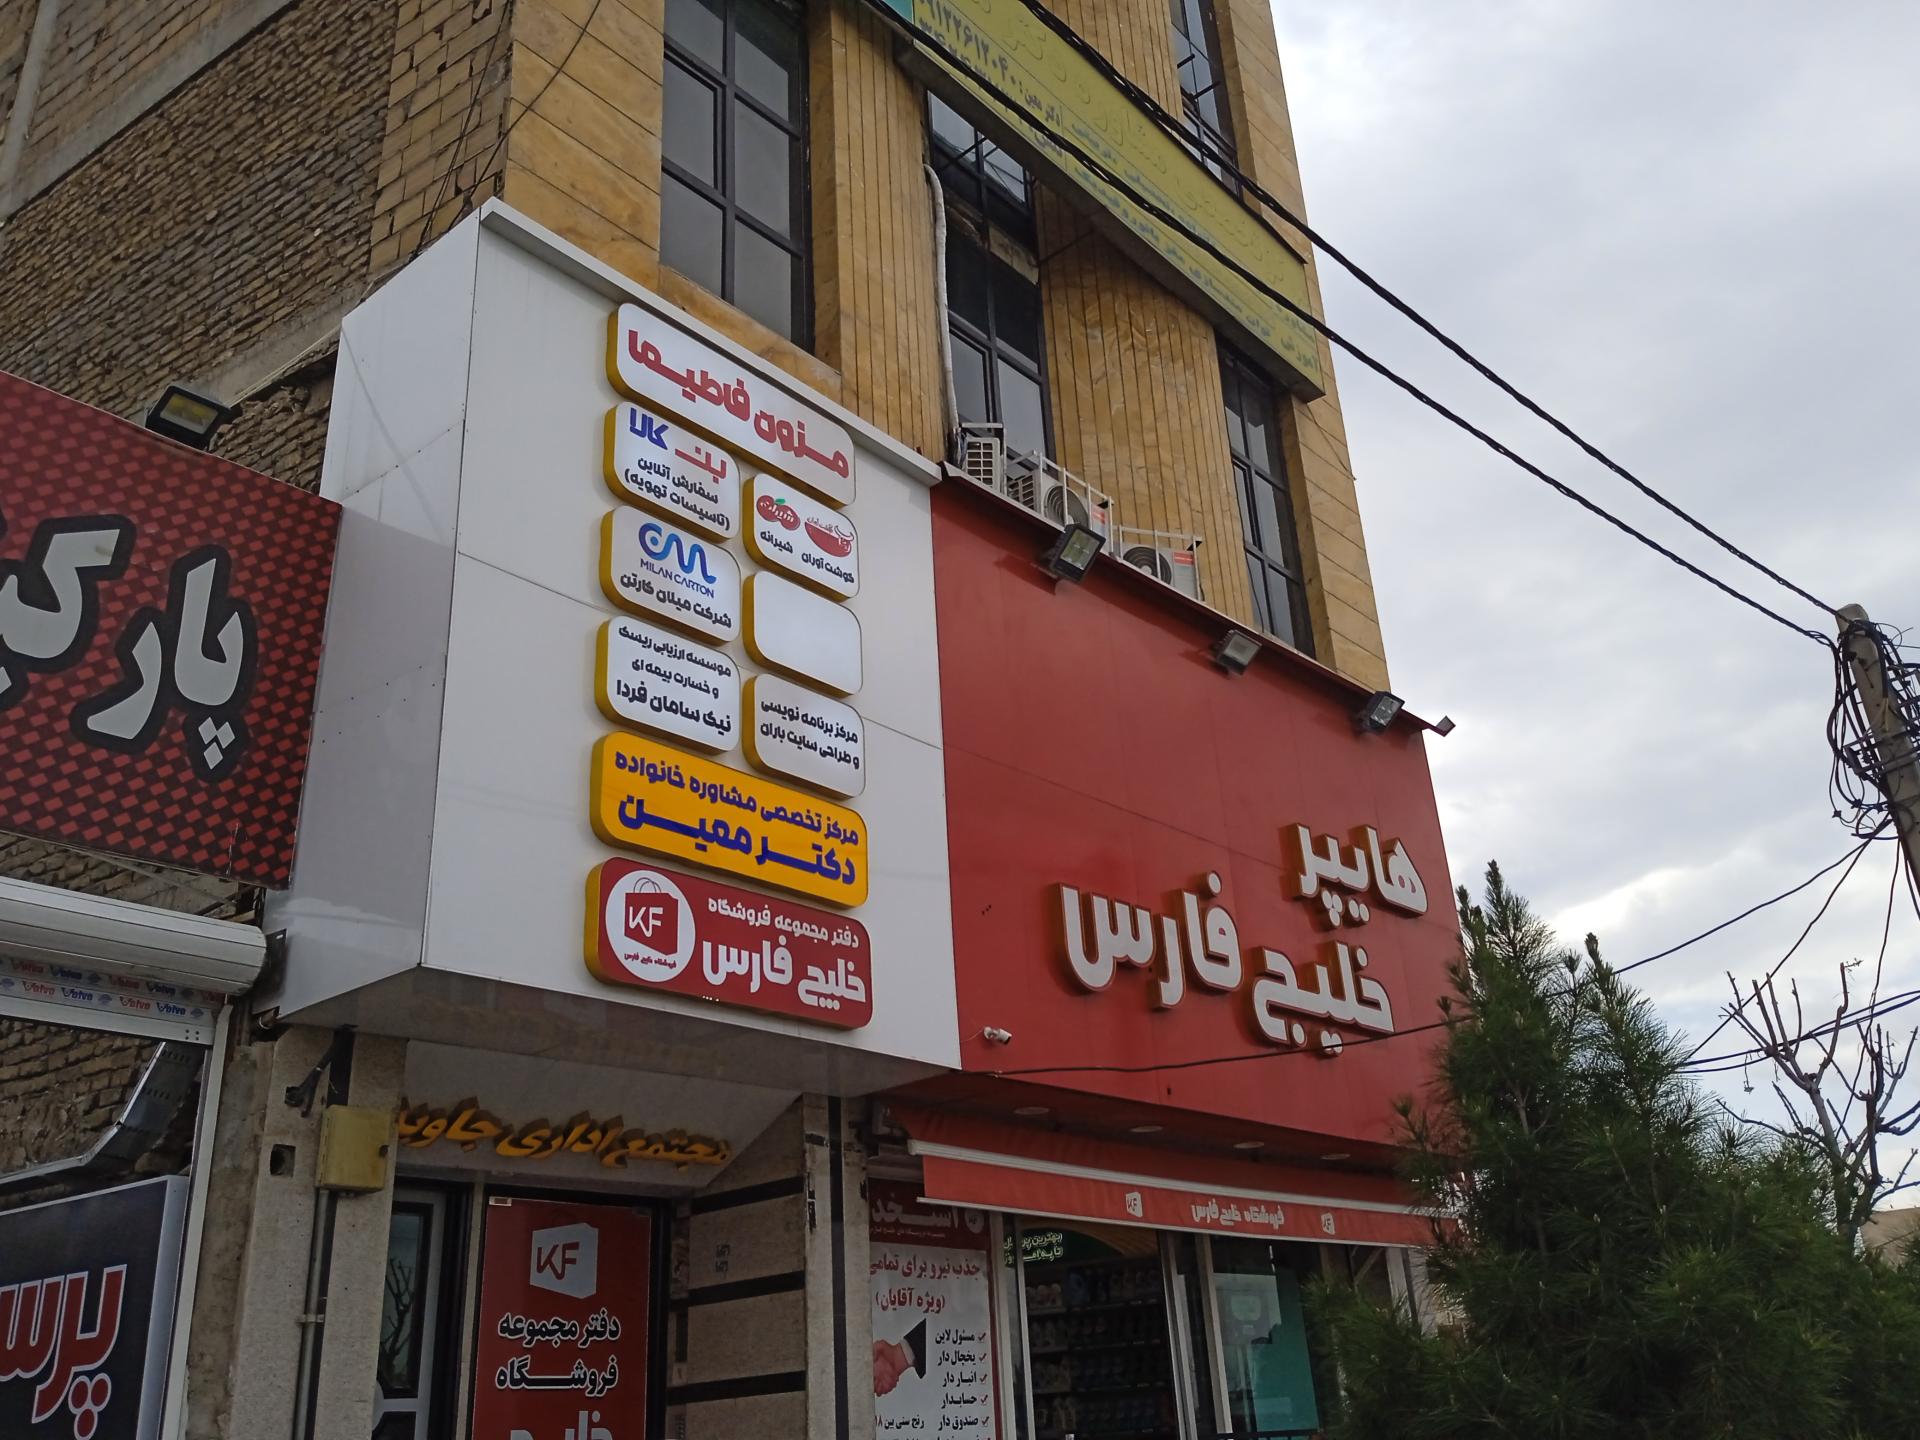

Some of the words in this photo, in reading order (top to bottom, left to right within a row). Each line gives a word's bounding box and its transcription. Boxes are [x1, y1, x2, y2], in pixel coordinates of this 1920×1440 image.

[628, 329, 750, 422] فاطیما
[753, 409, 849, 478] مزون
[637, 458, 671, 480] آنلاین
[672, 475, 719, 504] سفارش
[620, 572, 655, 594] کارتن
[640, 558, 673, 581] MILAN
[673, 573, 715, 599] CARTON
[656, 589, 692, 611] میلان
[693, 603, 732, 628] شرکت
[618, 626, 653, 649] ریسک
[653, 643, 685, 660] ارزیابی
[631, 658, 645, 672] ای
[645, 663, 672, 683] بیمه
[686, 652, 732, 677] موسسه
[616, 680, 648, 704] فردا
[673, 671, 711, 695] خسارت
[712, 687, 720, 700] و
[649, 695, 701, 723] سامان
[760, 701, 800, 721] نویسی
[702, 711, 732, 736] نیک
[760, 722, 786, 743] باران
[801, 713, 834, 737] برنامه
[834, 722, 858, 744] مرکز
[786, 730, 818, 753] سایت
[819, 745, 852, 764] طراحی
[852, 756, 860, 770] و
[615, 751, 686, 789] خانواده
[689, 775, 757, 813] مشاوره
[618, 795, 753, 853] معین
[760, 804, 823, 833] تخصصی
[824, 817, 859, 846] مرکز
[755, 836, 856, 885] دکتر
[1296, 822, 1428, 928] هایپر
[628, 905, 665, 938] KF
[708, 896, 771, 926] فروشگاه
[774, 914, 829, 944] مجموعه
[830, 925, 860, 949] دفتر
[1058, 870, 1243, 1009] فارس
[702, 935, 793, 994] فارس
[798, 957, 867, 1011] خلیج
[1250, 939, 1396, 1058] خلیج
[496, 1114, 625, 1159] اداری
[601, 1130, 731, 1173] مجتمع
[1191, 1198, 1219, 1223] فارس
[1219, 1203, 1242, 1226] خلیج
[1243, 1204, 1285, 1230] فروشگاه
[536, 1241, 580, 1281] KF
[902, 1255, 928, 1279] برای
[929, 1257, 952, 1280] نیرو
[952, 1259, 981, 1280] جذب
[498, 1312, 579, 1348] مجموعه
[578, 1307, 622, 1348] دفتر
[952, 1328, 976, 1345] مسئول
[938, 1350, 950, 1366] دار
[951, 1350, 976, 1366] یخچال
[496, 1354, 619, 1397] فروشگاه
[942, 1372, 954, 1387] دار
[956, 1371, 977, 1387] انبار
[938, 1415, 950, 1431] دار
[952, 1416, 979, 1430] صندوق
